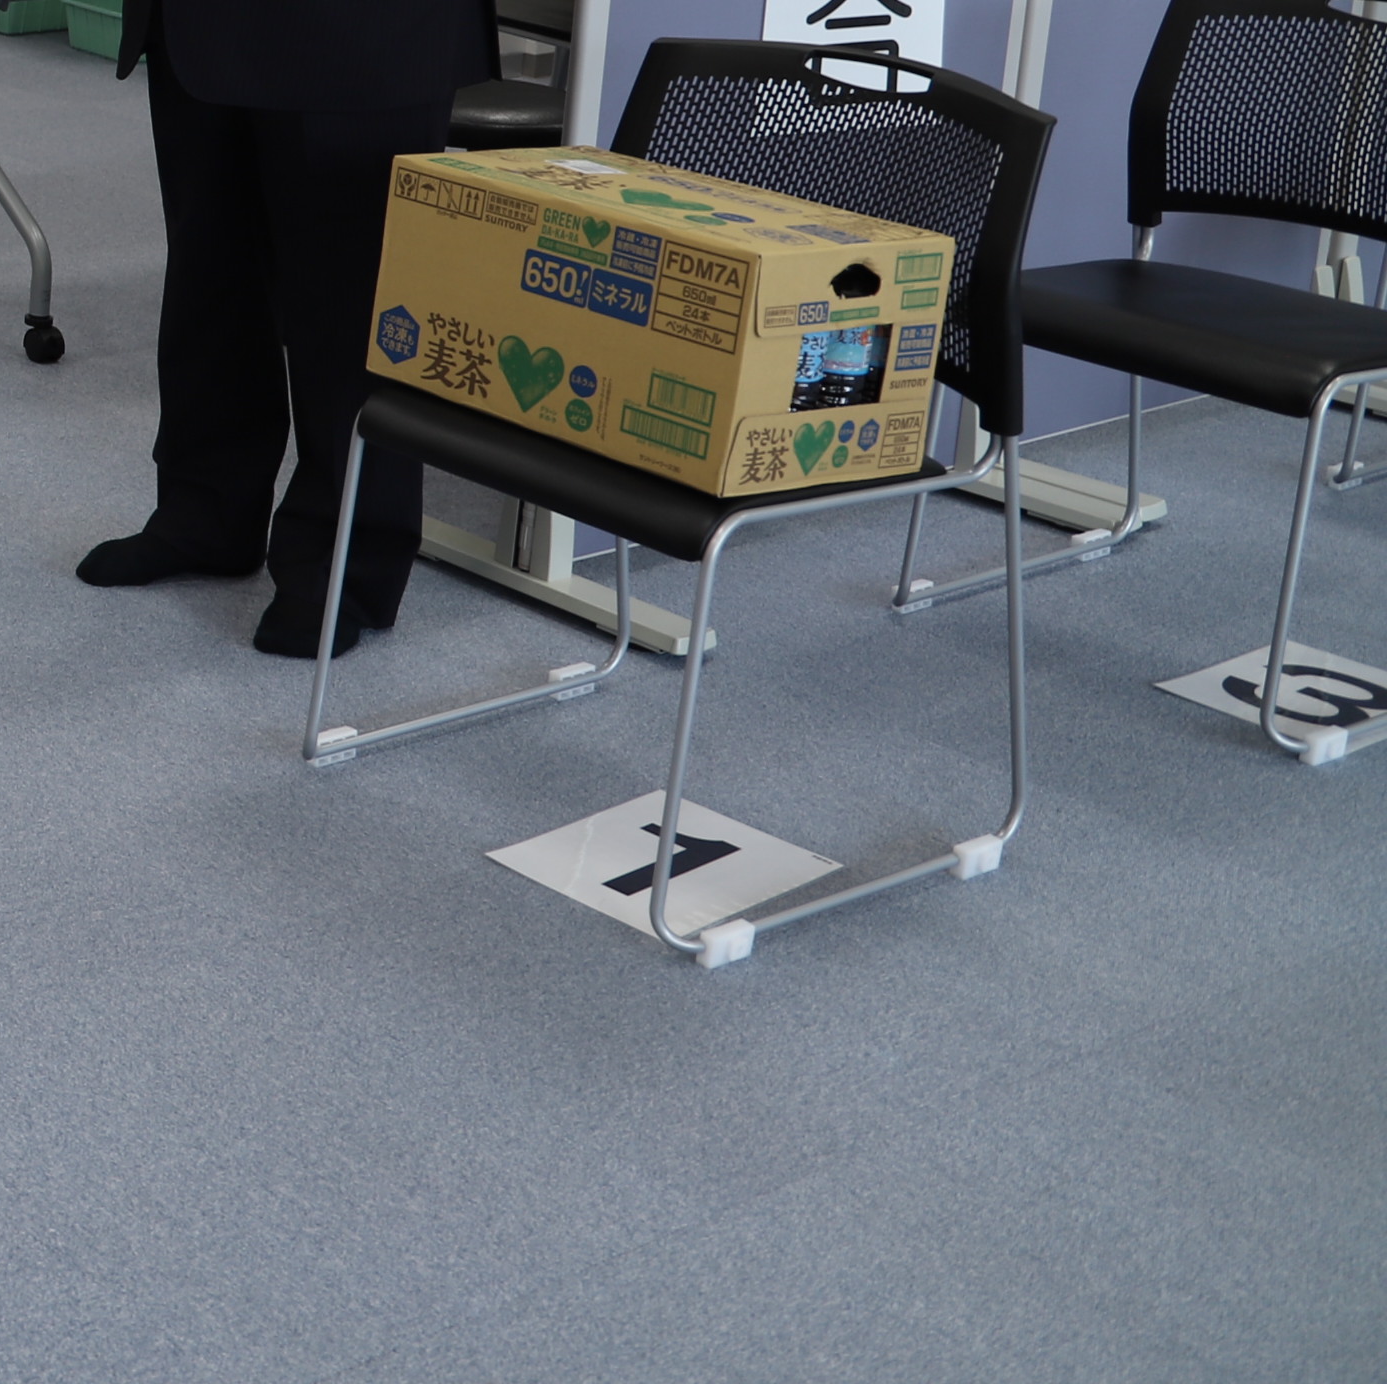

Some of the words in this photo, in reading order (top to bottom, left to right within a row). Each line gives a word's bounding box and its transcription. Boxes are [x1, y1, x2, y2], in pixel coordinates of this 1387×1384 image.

[543, 207, 581, 231] GREEN
[666, 250, 740, 289] FDM7A
[592, 280, 647, 314] ミネラル
[682, 285, 717, 306] 650ml
[682, 304, 711, 323] 24本
[381, 323, 415, 346] 冷凍も
[427, 312, 495, 349] やさしい
[666, 320, 723, 346] ペットボトル
[420, 338, 493, 399] 麦茶
[570, 414, 587, 428] ゼロ
[887, 417, 922, 432] FDM7A
[746, 427, 793, 448] やさしい
[739, 446, 789, 486] 麦茶
[601, 822, 742, 896] 1
